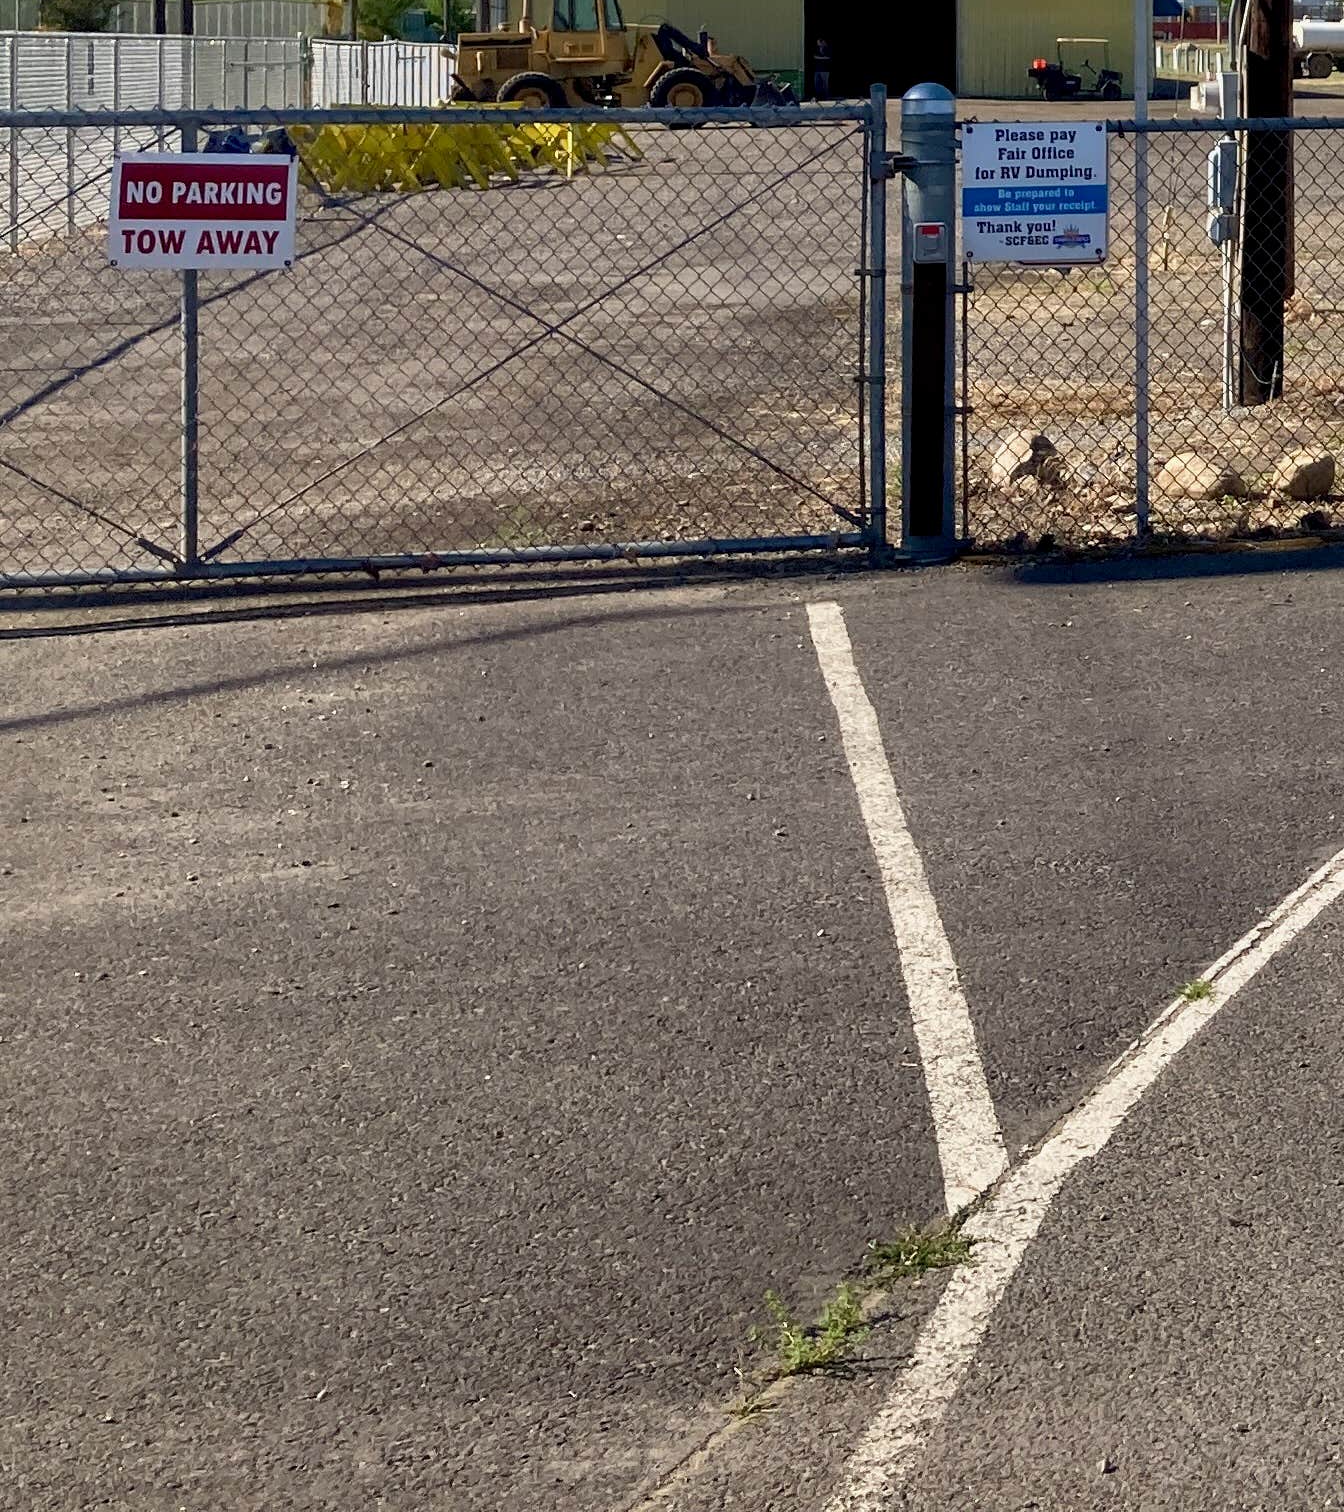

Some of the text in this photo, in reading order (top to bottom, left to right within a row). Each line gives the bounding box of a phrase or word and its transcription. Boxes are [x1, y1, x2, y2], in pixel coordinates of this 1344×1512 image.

[995, 129, 1077, 143] Please pay
[998, 147, 1075, 160] Fair Office
[975, 165, 1097, 180] for RV Dumping.
[126, 180, 282, 206] NO PARKING
[998, 187, 1075, 200] Be prepared to
[974, 202, 1002, 212] show
[1005, 201, 1030, 212] Staff
[1032, 202, 1058, 213] your
[976, 219, 1056, 235] Thank you!
[121, 229, 280, 255] TOW AWAY
